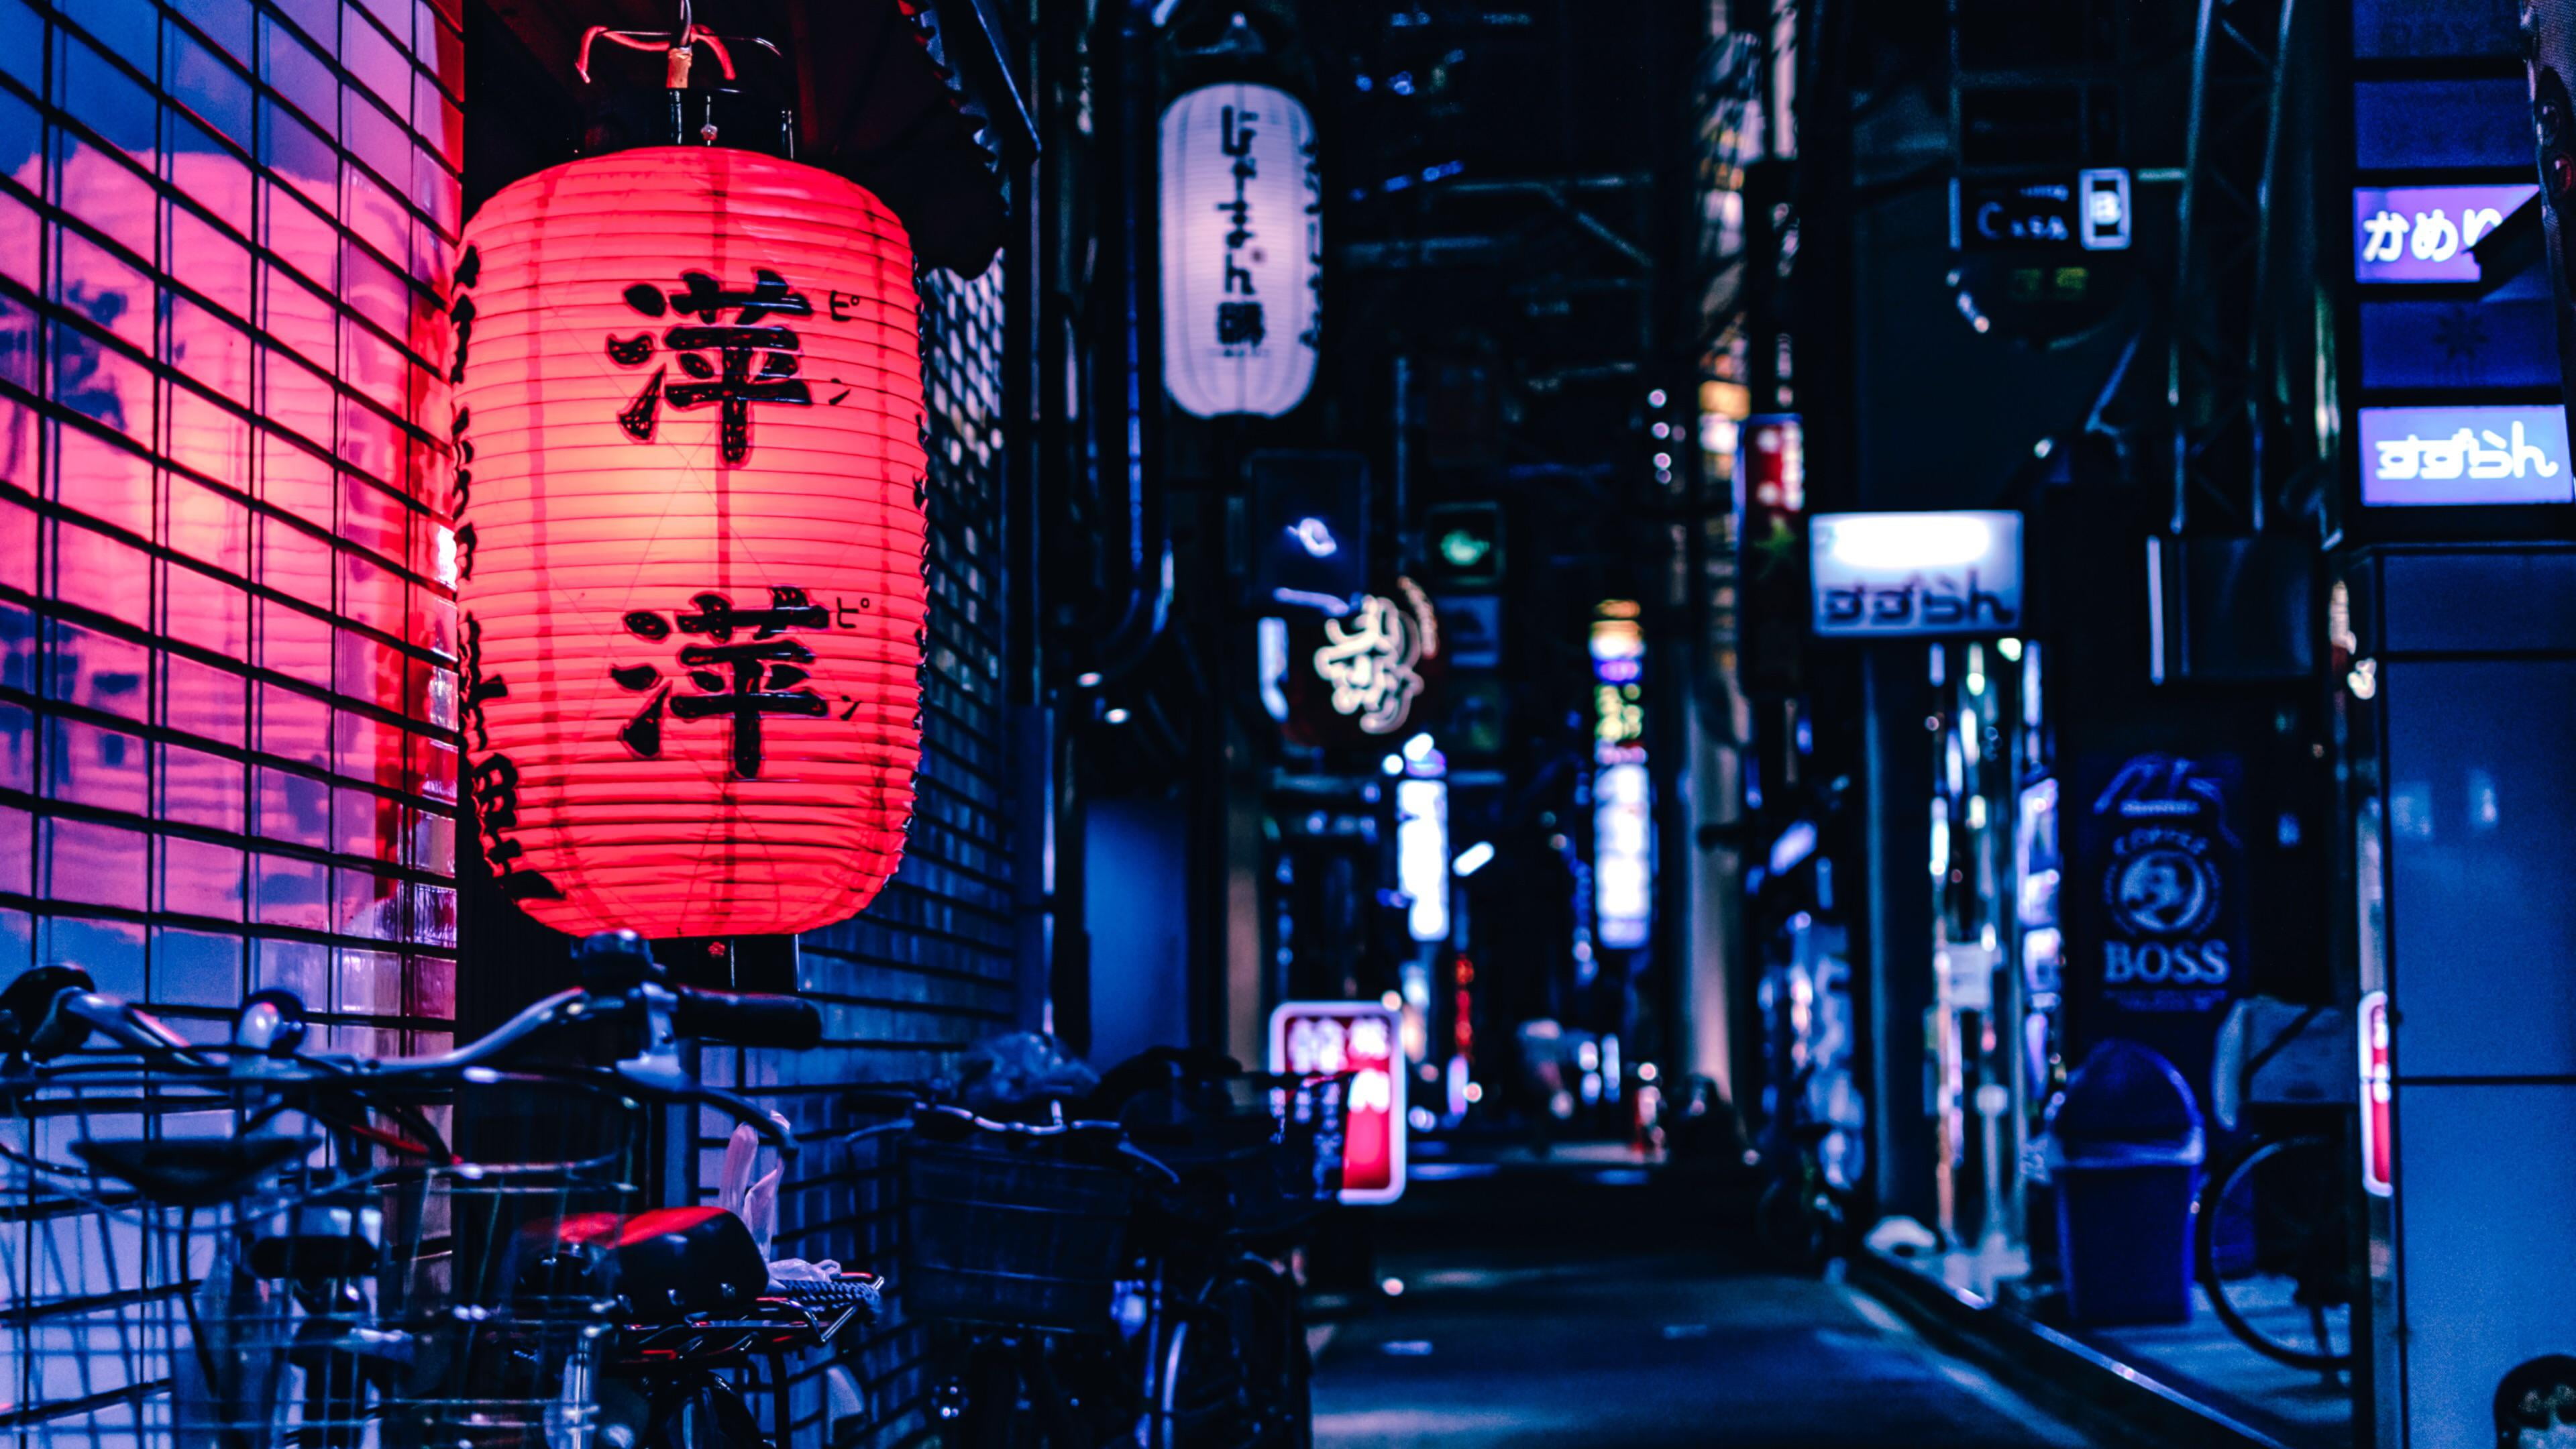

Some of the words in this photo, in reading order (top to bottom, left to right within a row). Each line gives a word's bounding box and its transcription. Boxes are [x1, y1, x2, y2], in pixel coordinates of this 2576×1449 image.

[2375, 421, 2558, 479] すずらん
[1823, 568, 2015, 625] すずらん
[2103, 939, 2231, 984] BOSS
